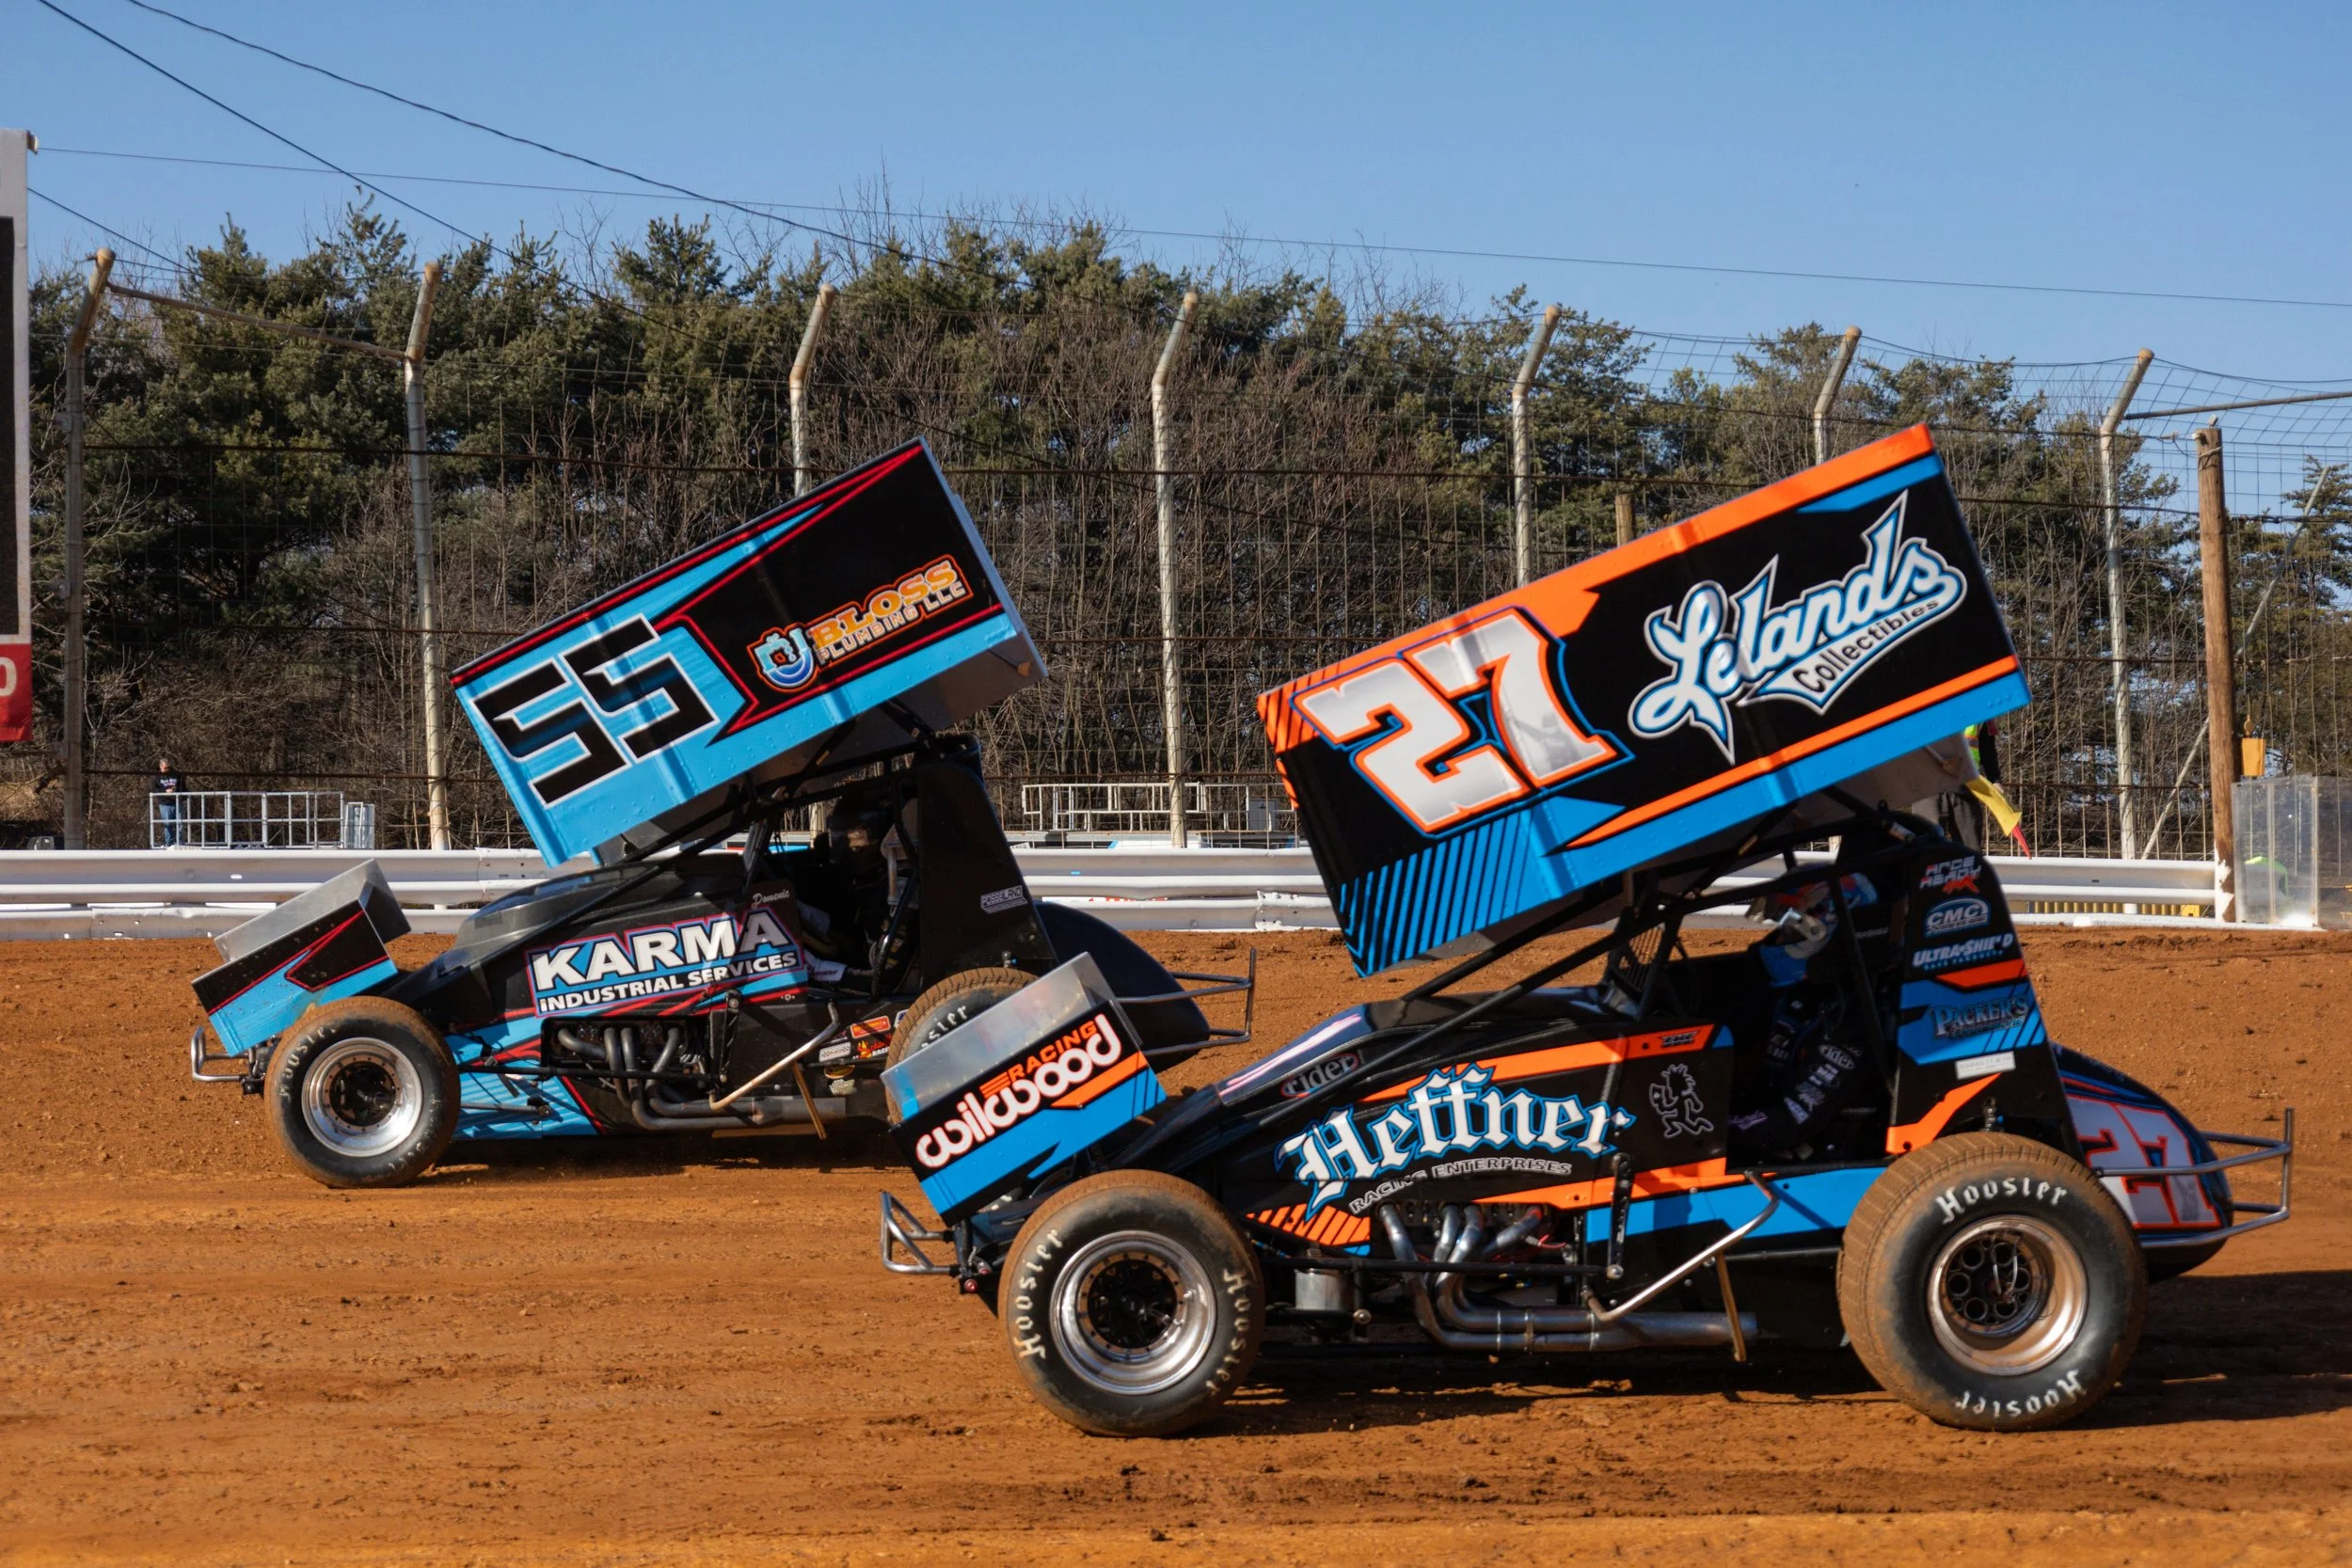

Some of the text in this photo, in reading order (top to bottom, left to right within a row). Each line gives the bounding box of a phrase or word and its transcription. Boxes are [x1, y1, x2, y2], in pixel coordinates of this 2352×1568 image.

[807, 560, 958, 651] BLOSS
[815, 581, 967, 665] PLUMBING LLC
[1628, 489, 1967, 766] Lelands
[1792, 598, 1939, 692] Collectibles
[1294, 612, 1619, 833] 27
[532, 911, 790, 990] KARMA
[1926, 904, 1981, 927] CMC
[538, 953, 798, 1012] INDUSTRIAL SERVICES
[915, 1013, 1122, 1168] wilwood
[1007, 1021, 1098, 1083] RACING
[1284, 1054, 1356, 1095] rider
[1275, 1062, 1637, 1222] Heffner
[1349, 1157, 1573, 1214] RACING ENTERPRISES
[1935, 1176, 2068, 1224] Hoosier
[1013, 1228, 1064, 1360] Hoosier
[1204, 1268, 1252, 1394] Hoosier
[1955, 1369, 2089, 1418] Hoosier
